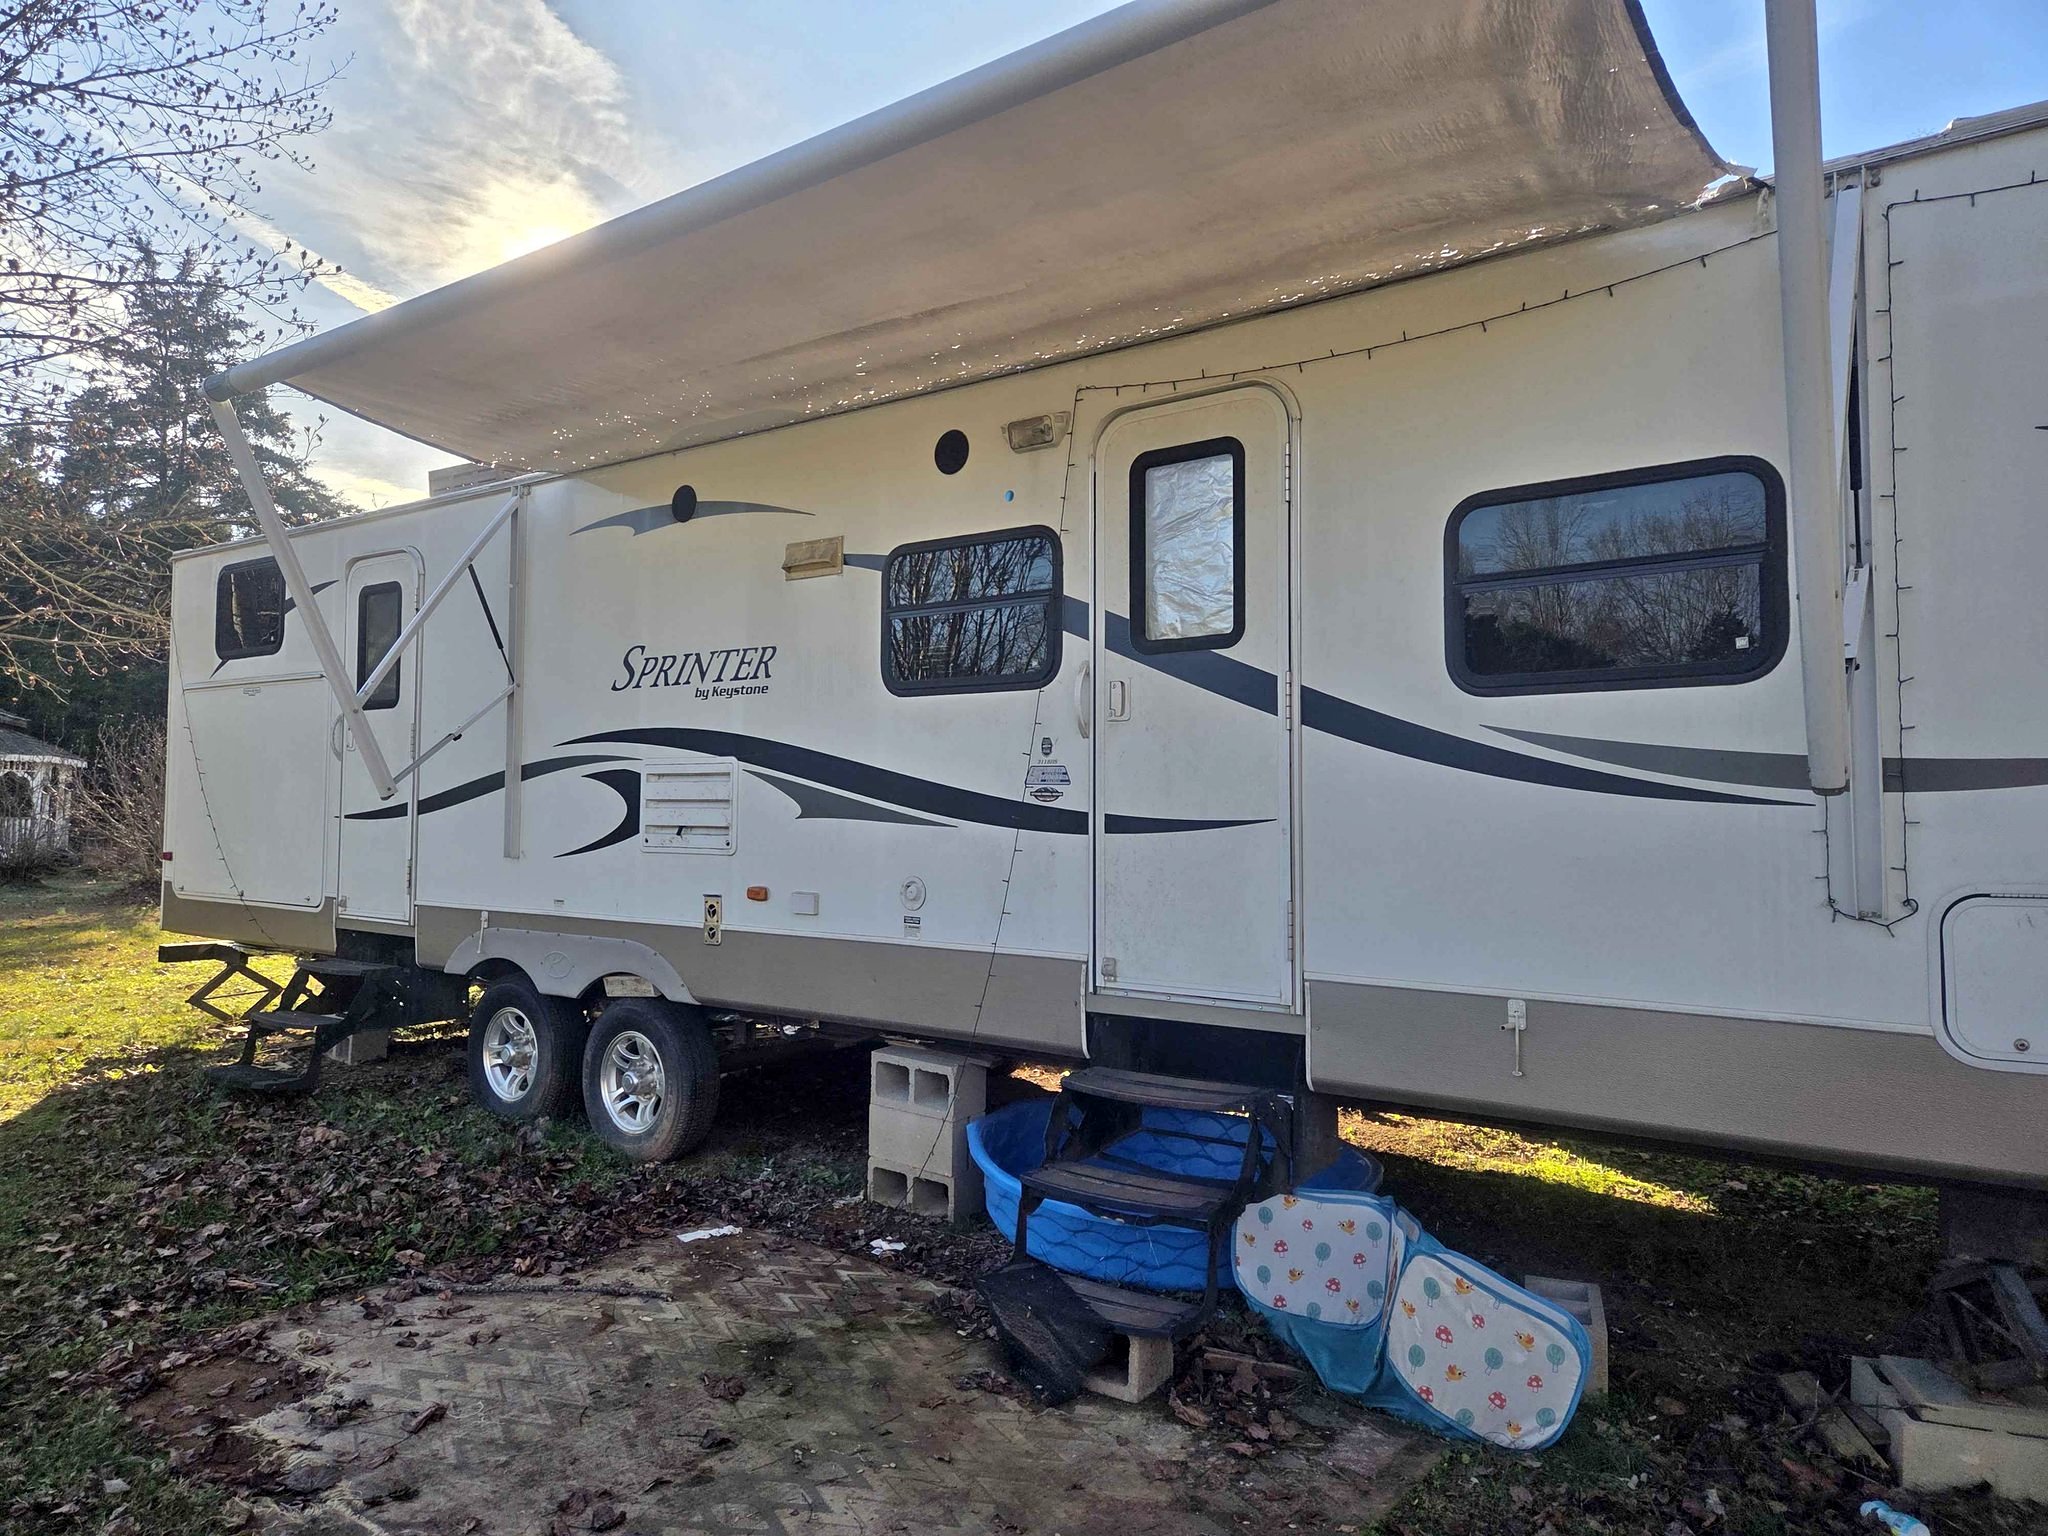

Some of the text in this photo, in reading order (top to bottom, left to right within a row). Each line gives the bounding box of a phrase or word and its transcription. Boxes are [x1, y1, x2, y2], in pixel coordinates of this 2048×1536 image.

[611, 645, 777, 691] SPRINTER
[695, 685, 769, 701] by Keystone
